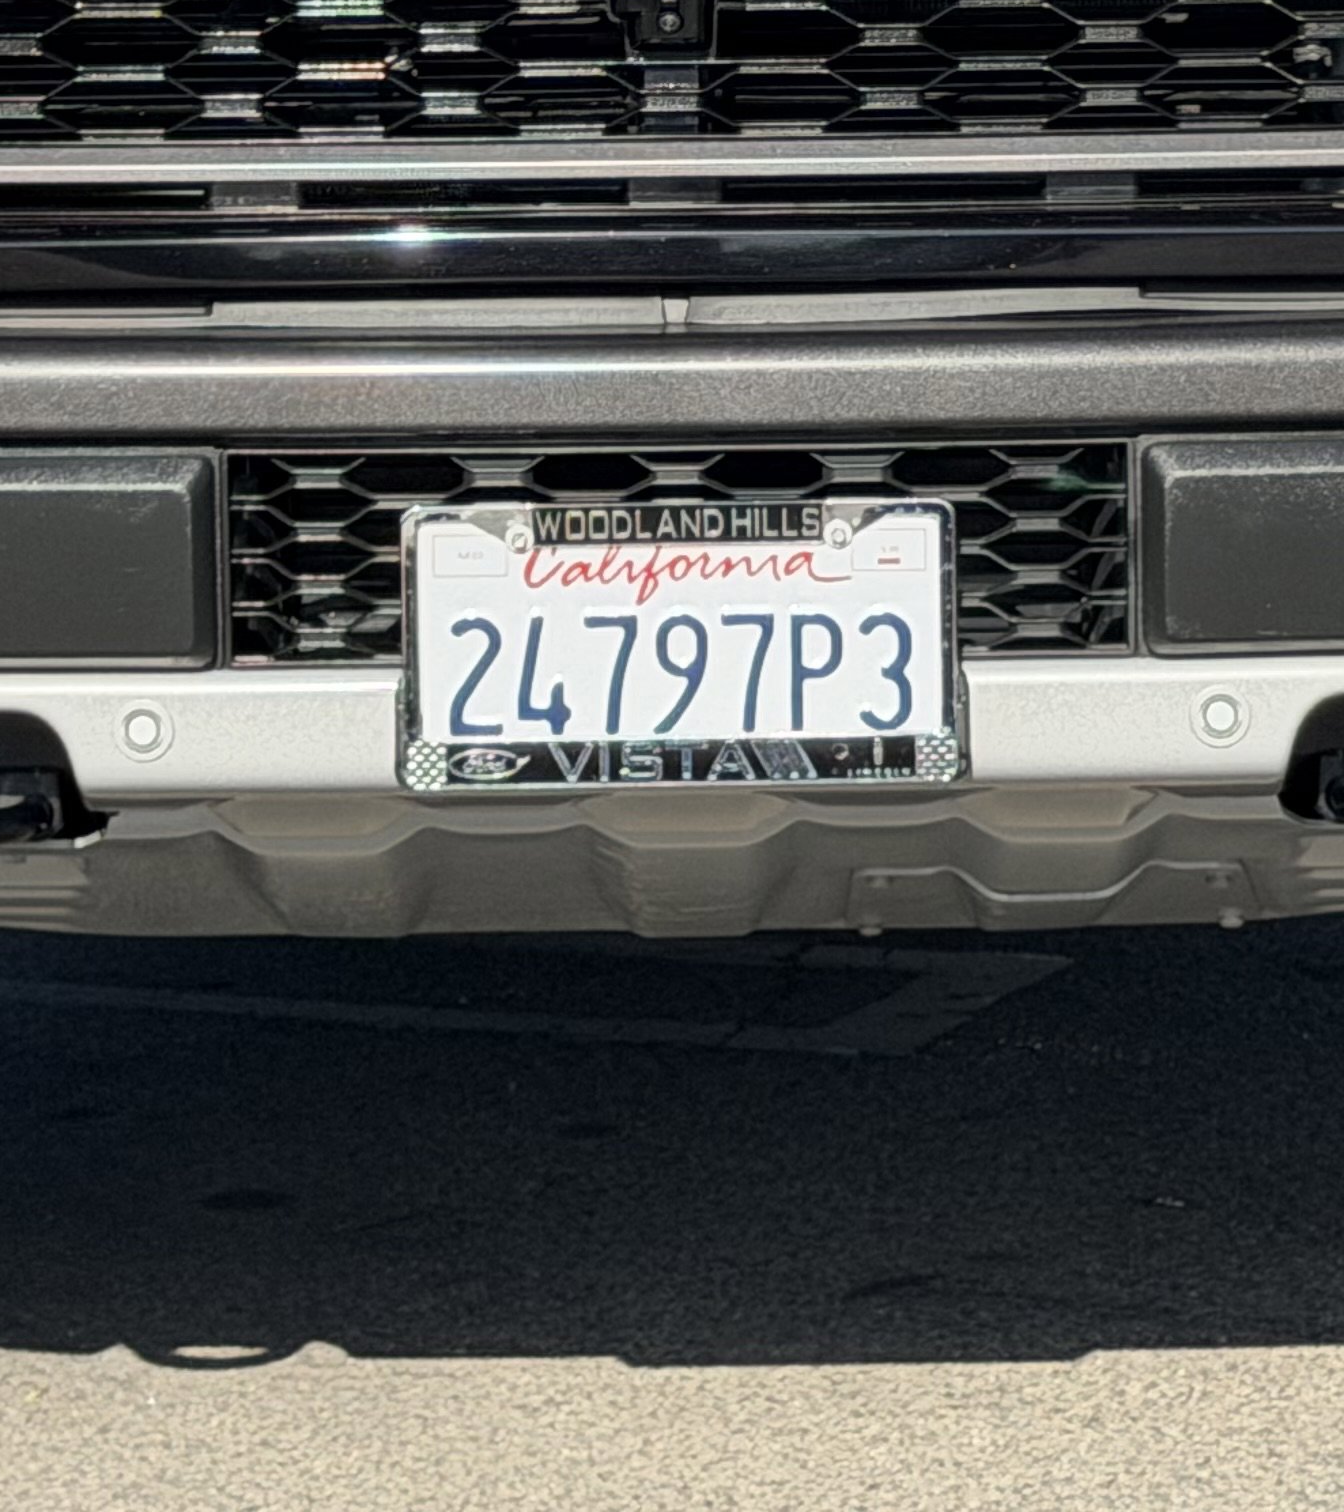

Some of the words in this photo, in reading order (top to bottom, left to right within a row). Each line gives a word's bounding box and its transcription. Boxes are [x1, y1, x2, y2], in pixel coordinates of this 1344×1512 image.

[730, 505, 822, 538] HILLS
[523, 545, 853, 606] California
[449, 611, 914, 736] 24797P3
[549, 739, 756, 783] VISTA
